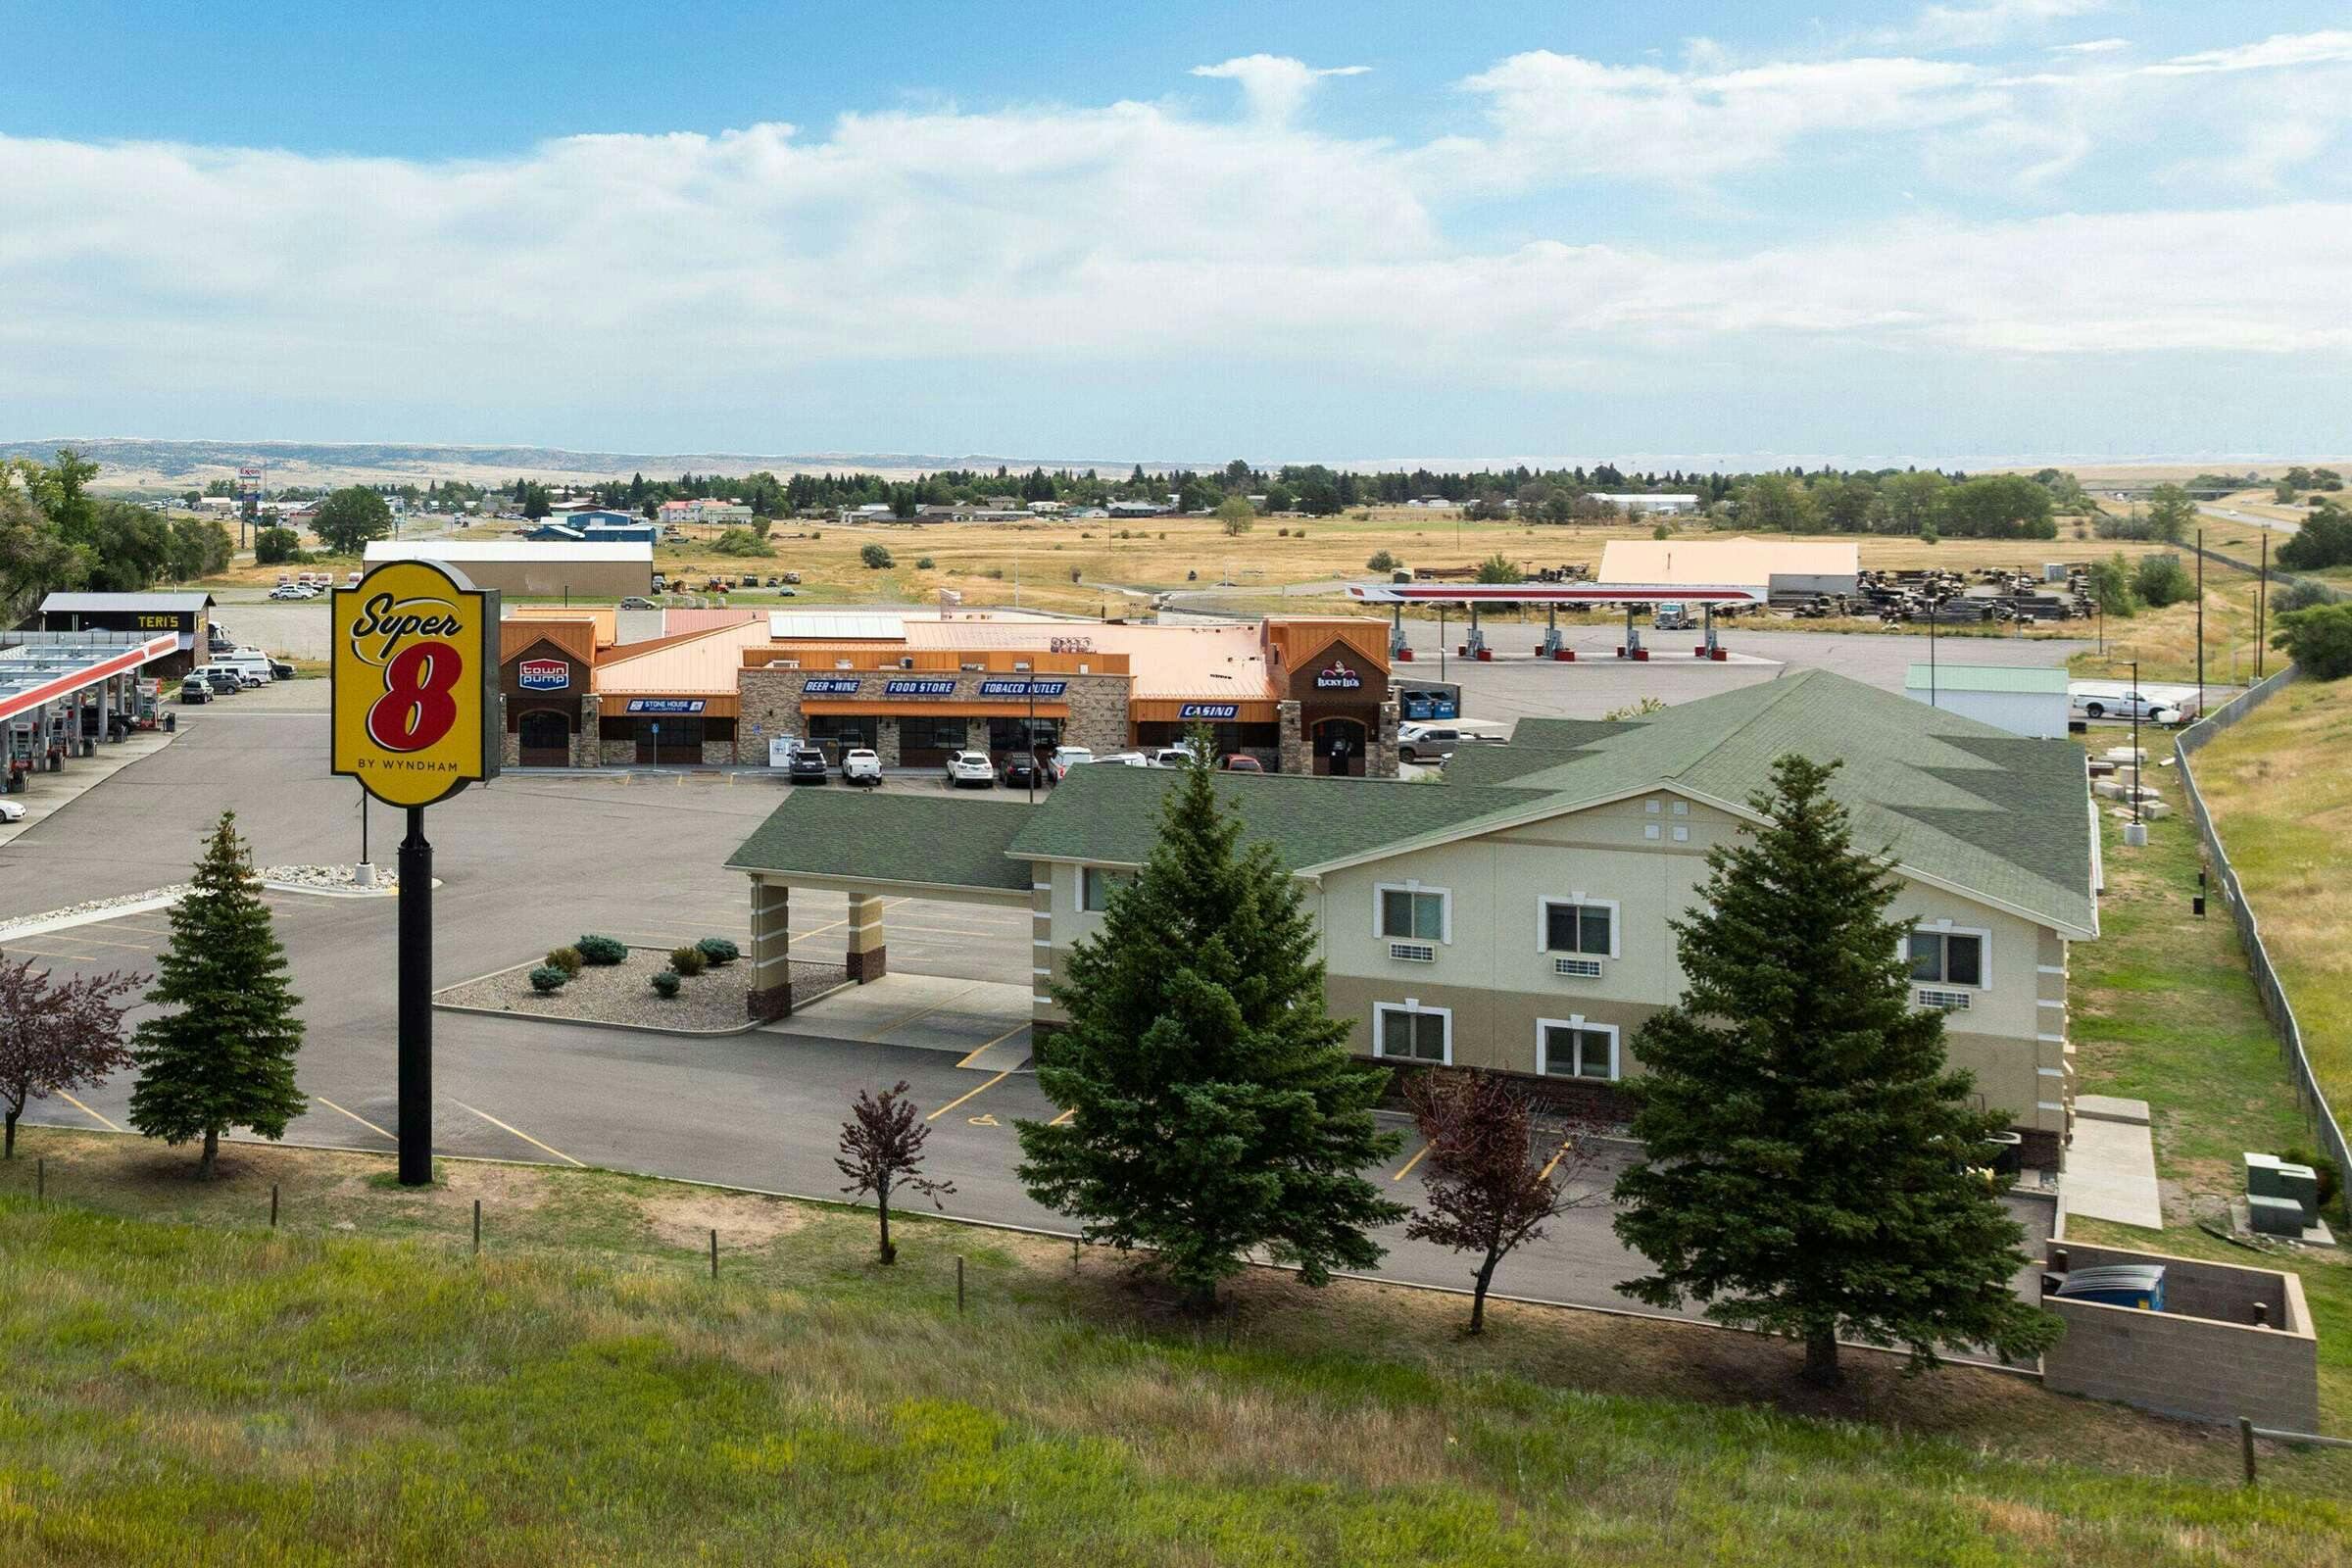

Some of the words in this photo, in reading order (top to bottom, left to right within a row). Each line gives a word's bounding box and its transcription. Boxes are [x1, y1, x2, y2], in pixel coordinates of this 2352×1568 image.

[138, 615, 179, 627] TERI'S
[352, 593, 463, 659] Super
[522, 665, 564, 674] town
[523, 674, 564, 684] pump
[806, 681, 829, 692] BEER
[835, 681, 858, 692] WINE
[889, 682, 916, 692] FOOD
[919, 682, 953, 693] STORE
[984, 683, 1025, 693] TOBACCO
[366, 641, 464, 753] 8
[1185, 706, 1234, 715] CASINO
[358, 759, 375, 768] BY
[383, 760, 458, 772] WYNDHAM
